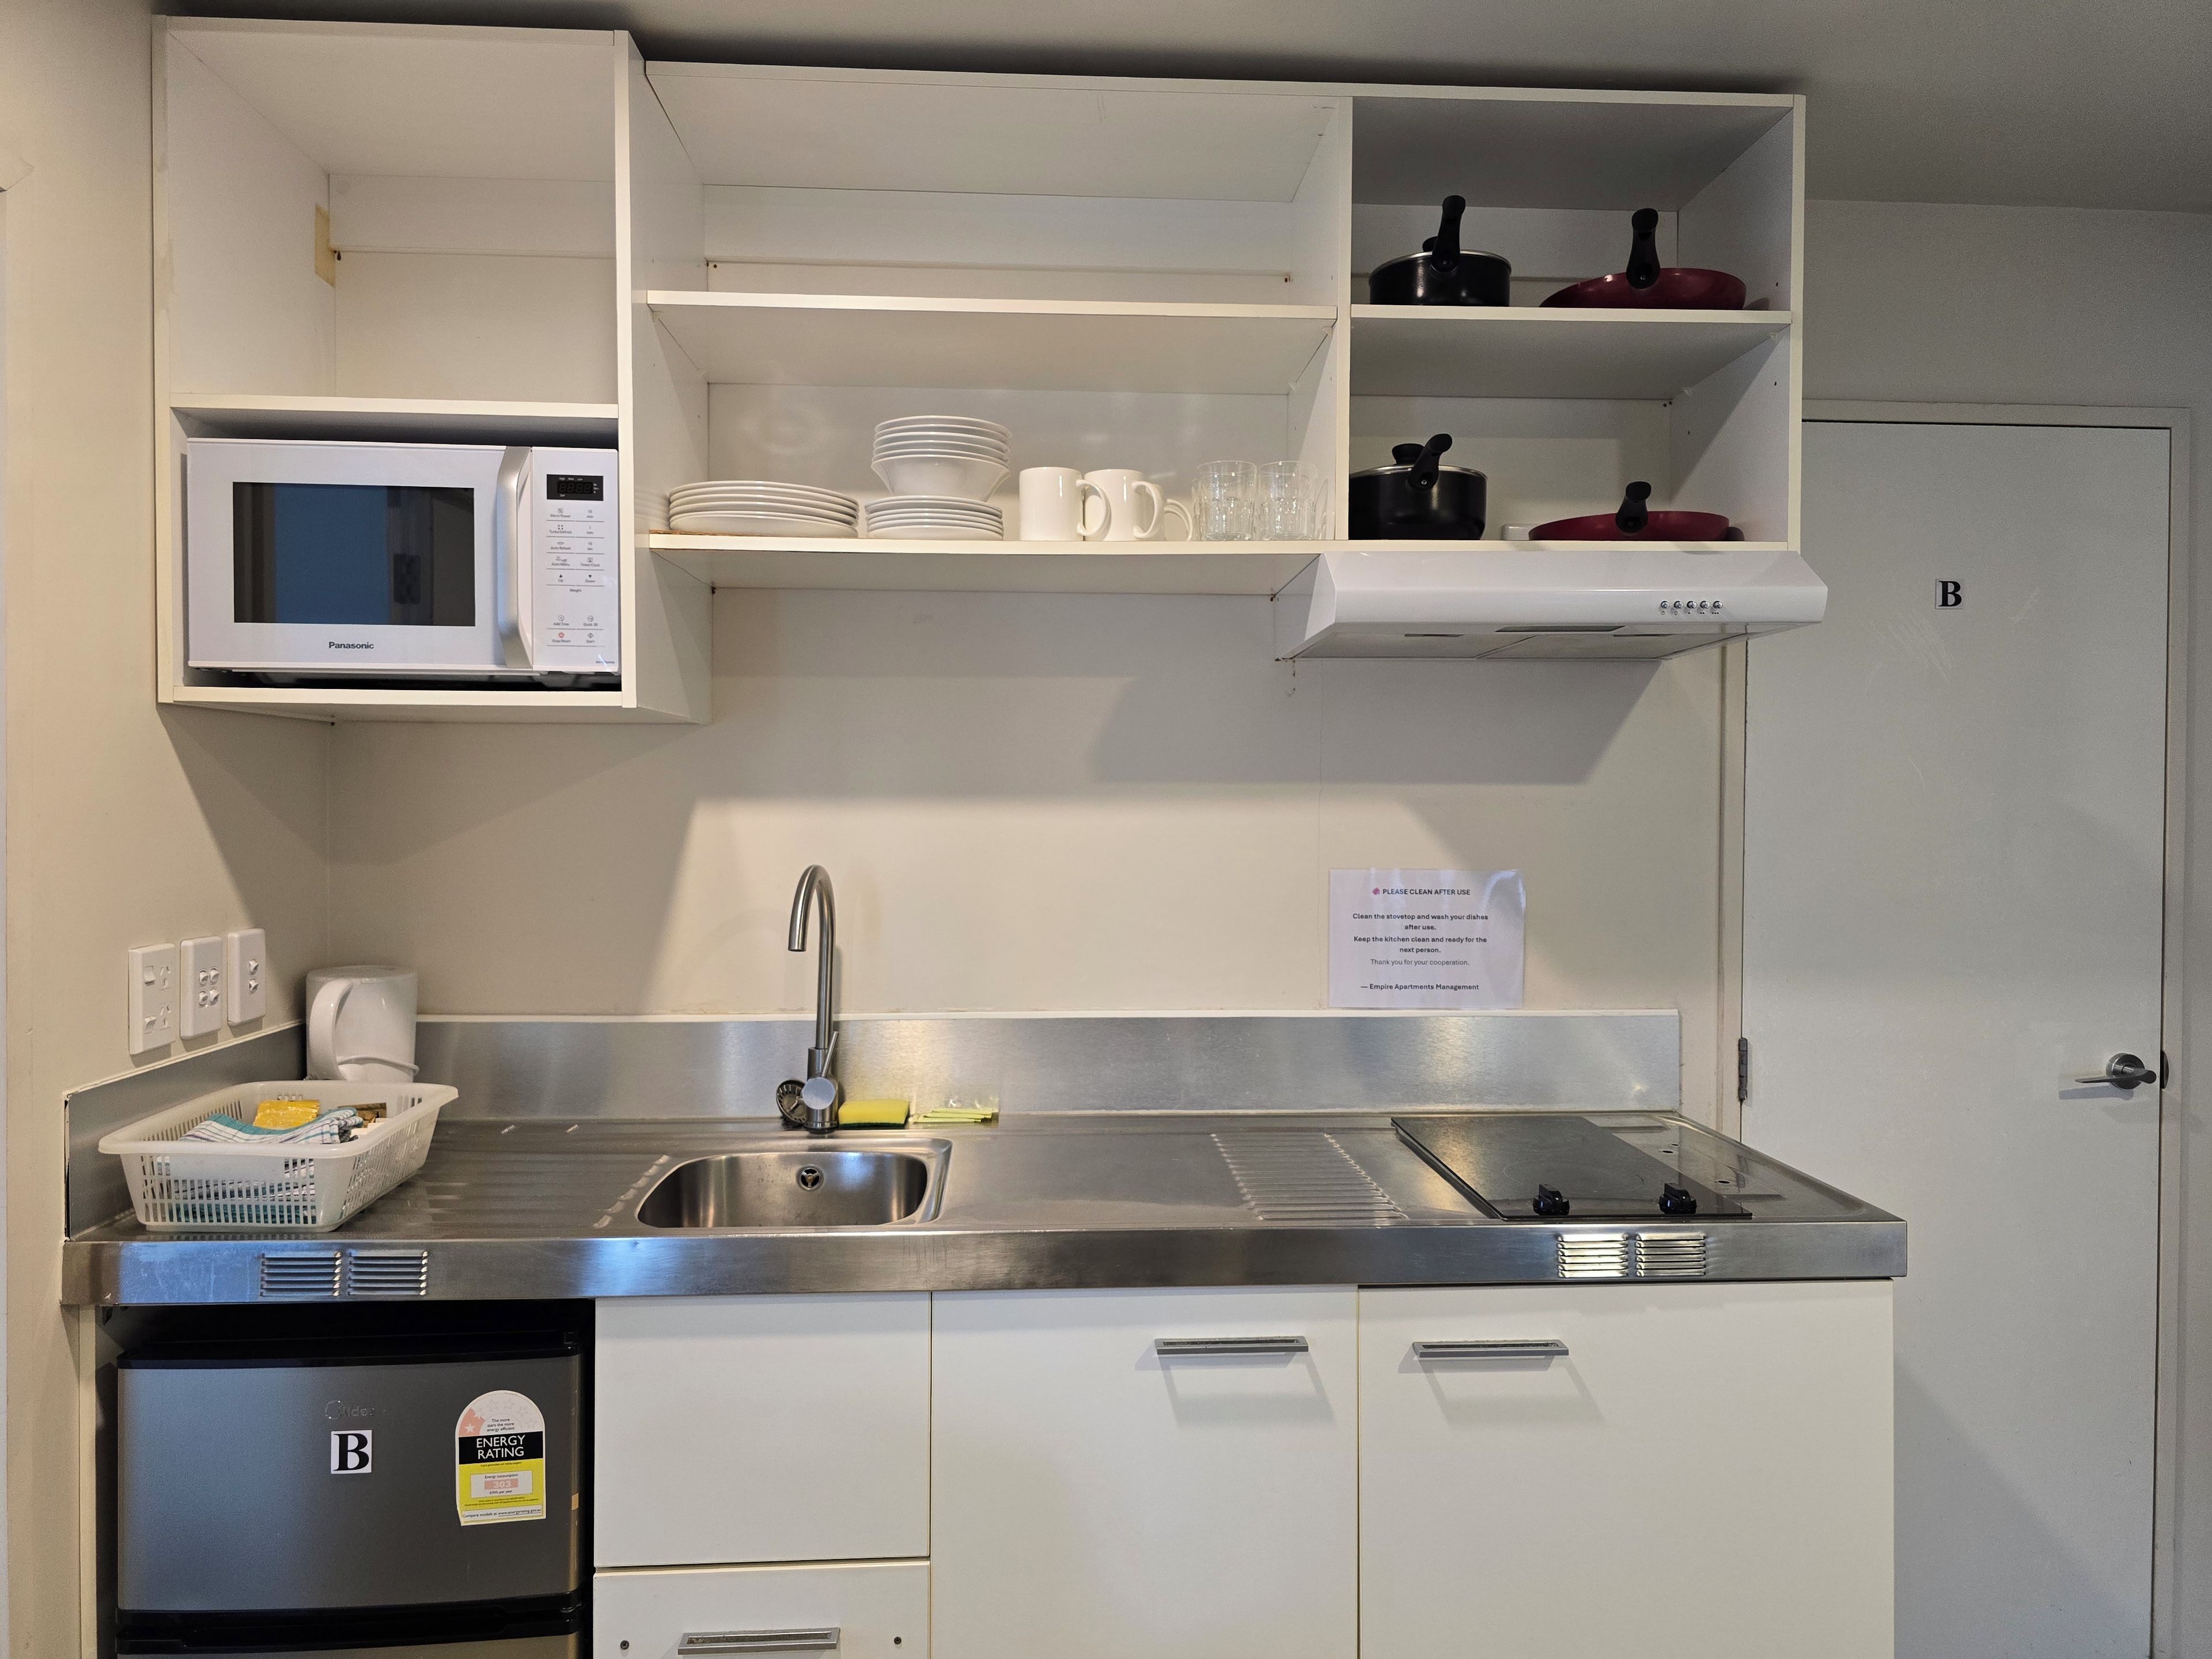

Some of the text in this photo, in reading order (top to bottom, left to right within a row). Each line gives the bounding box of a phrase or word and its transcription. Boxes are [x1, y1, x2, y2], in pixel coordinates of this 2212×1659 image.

[1938, 581, 1962, 607] B
[476, 1435, 525, 1448] ENERGY
[333, 1433, 369, 1471] B
[478, 1446, 524, 1460] RATING
[494, 1480, 512, 1488] 303
